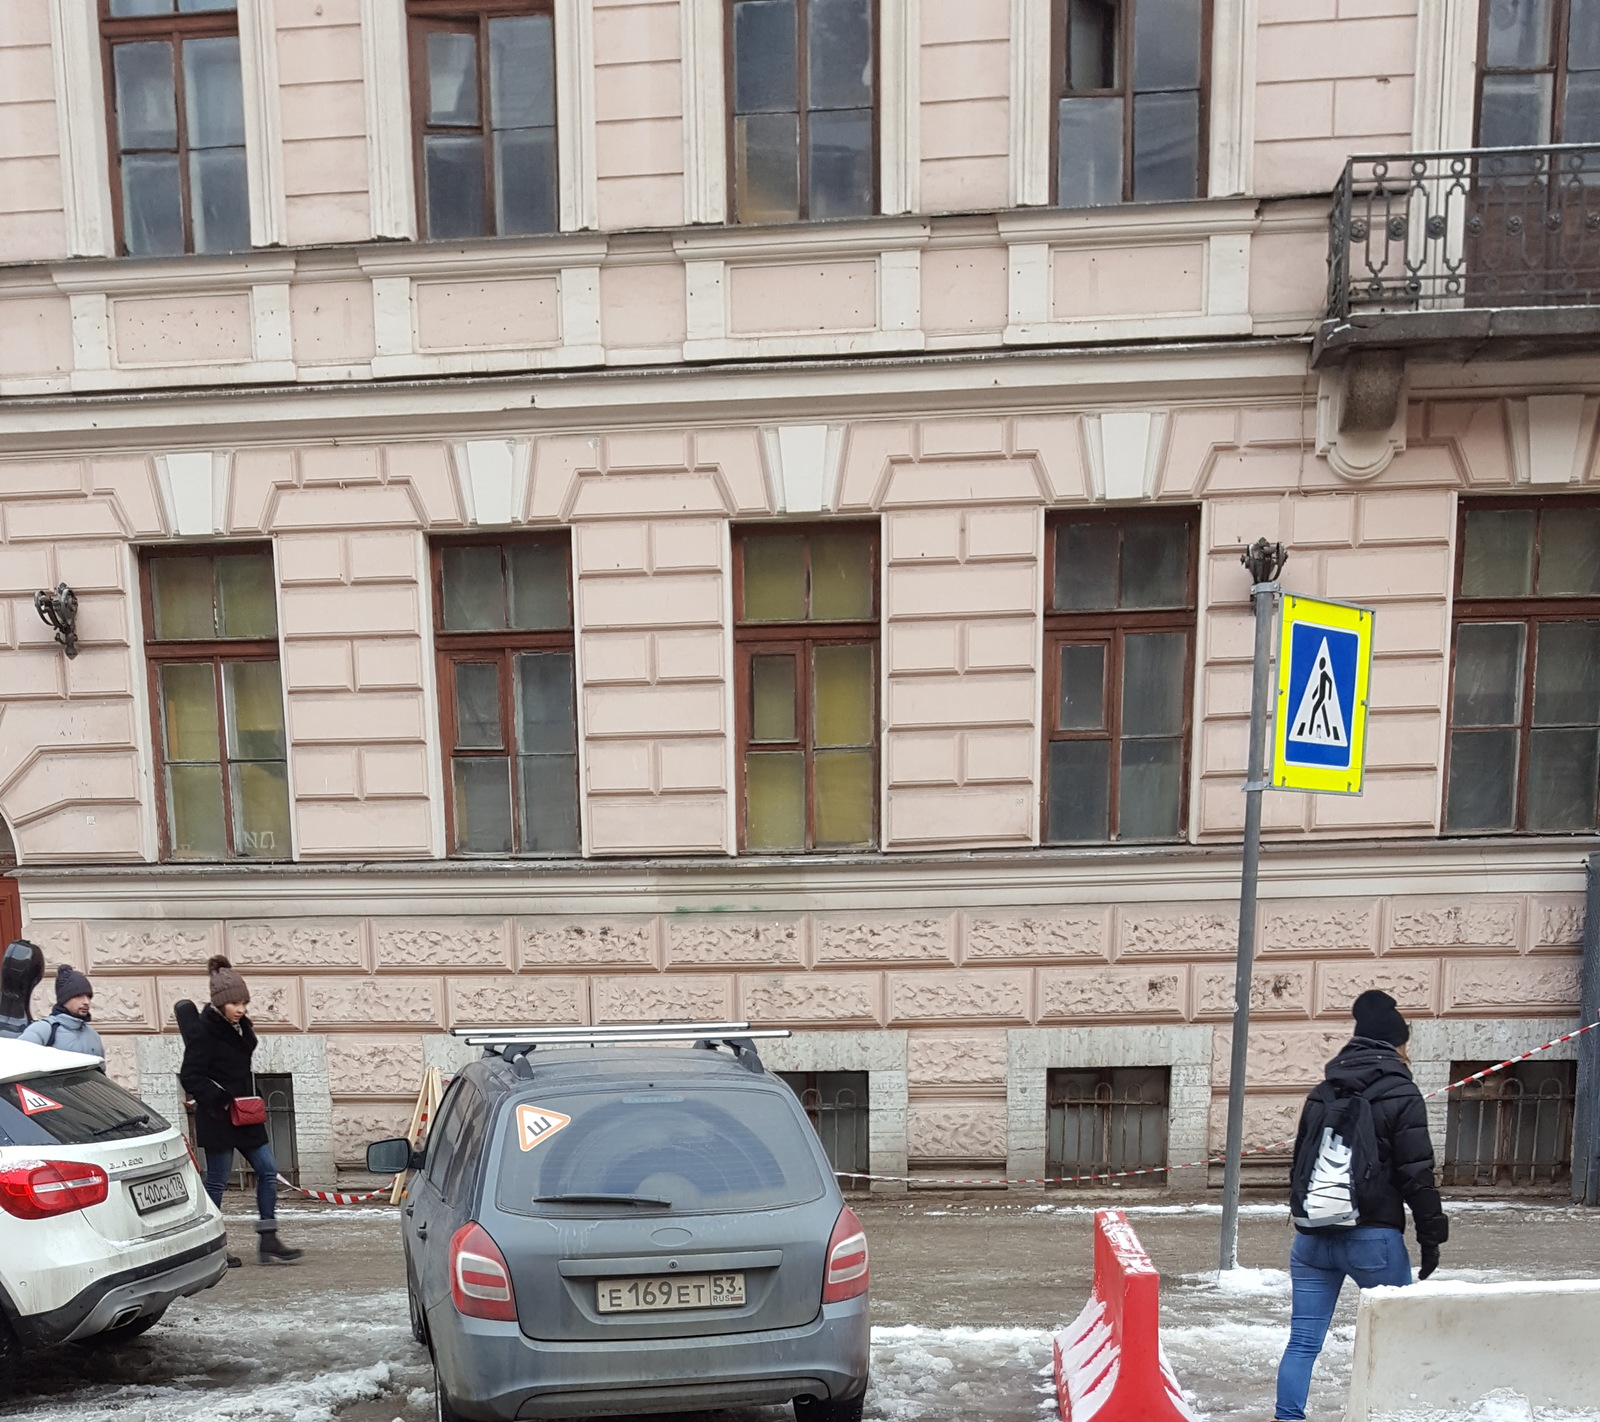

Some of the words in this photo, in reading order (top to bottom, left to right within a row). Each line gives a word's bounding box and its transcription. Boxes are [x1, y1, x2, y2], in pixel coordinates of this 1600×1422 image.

[27, 1097, 47, 1108] Ш
[527, 1116, 552, 1137] Ш
[1303, 1127, 1356, 1225] NIKE
[713, 1276, 736, 1295] 53
[712, 1295, 730, 1303] RUS
